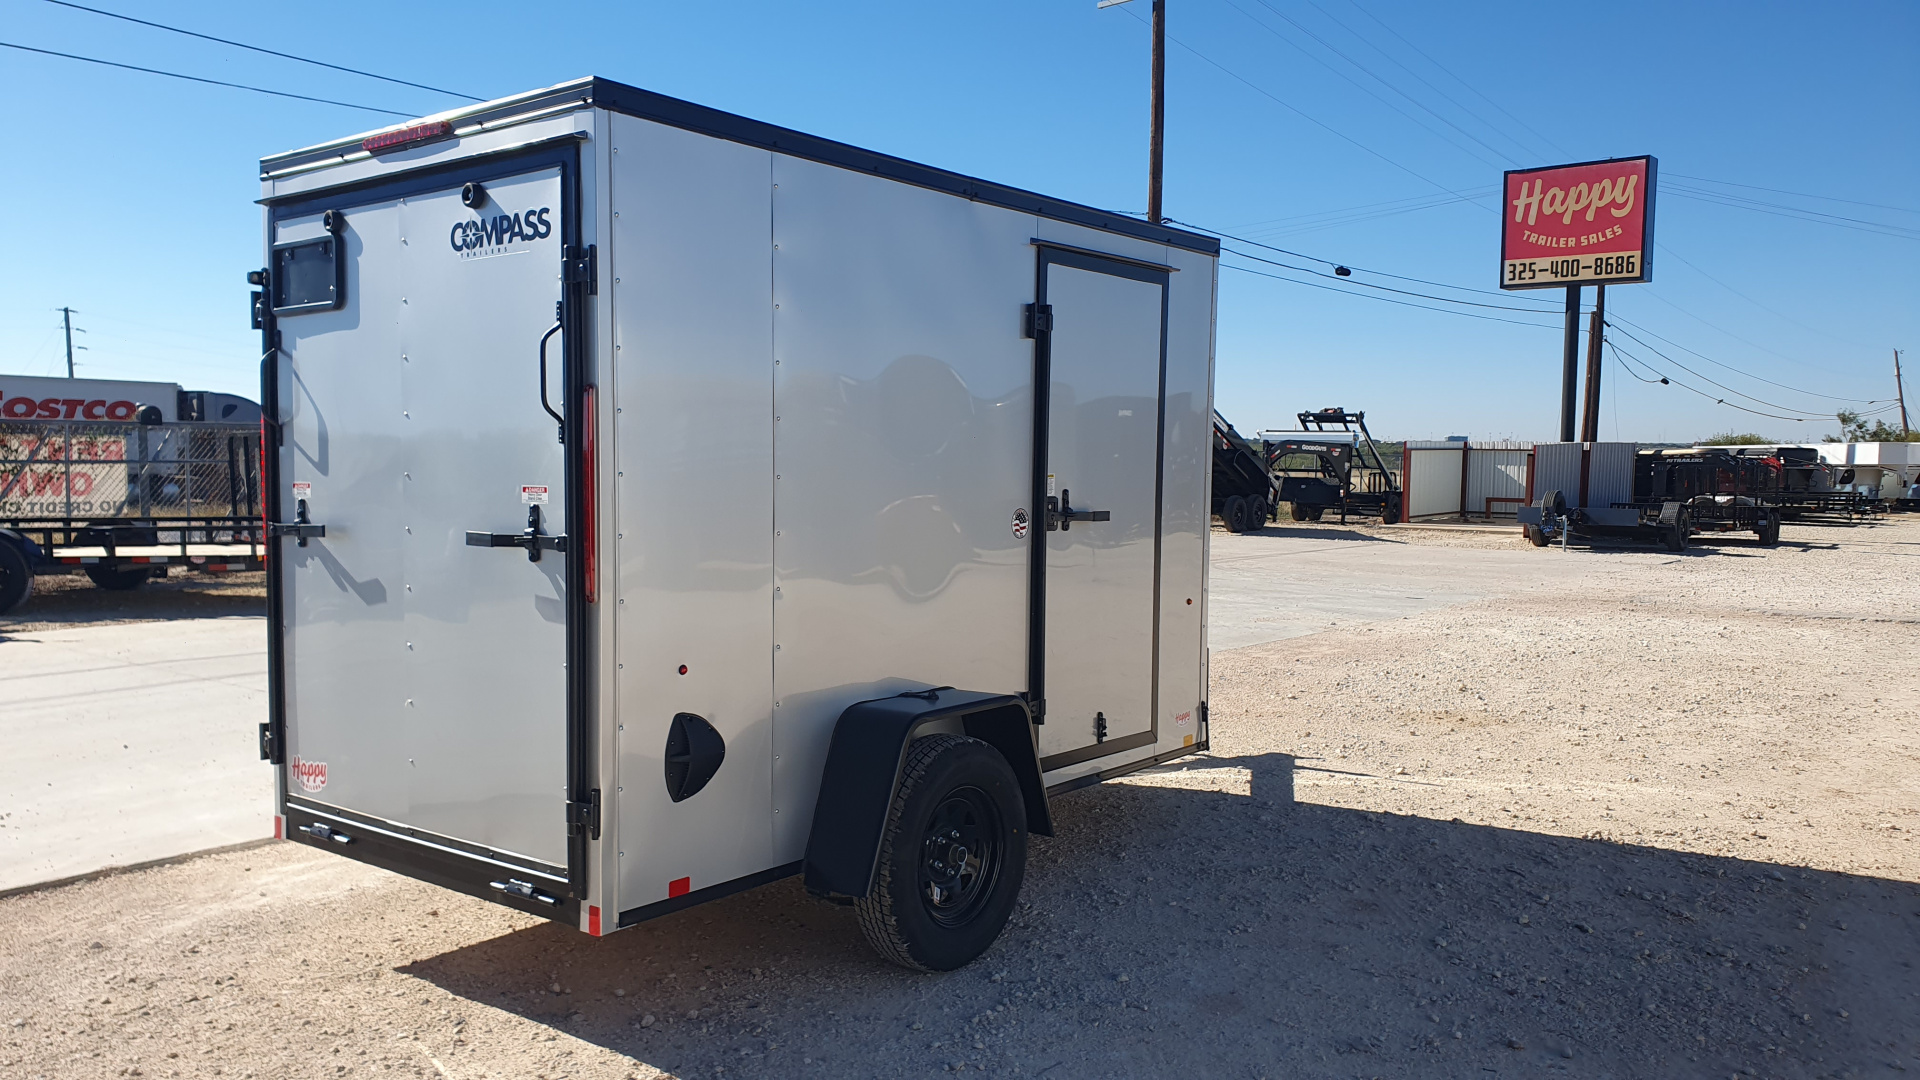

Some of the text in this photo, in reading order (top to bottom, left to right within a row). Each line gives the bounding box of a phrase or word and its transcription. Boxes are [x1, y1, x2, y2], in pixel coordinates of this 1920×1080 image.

[1513, 175, 1638, 225] Happy
[450, 207, 552, 251] COMPASS
[1522, 224, 1623, 248] TRAILER SALES
[460, 246, 508, 259] TRAILERS
[1508, 255, 1635, 281] 325-400-8686
[0, 391, 137, 420] OSTCO
[292, 756, 327, 784] Happy
